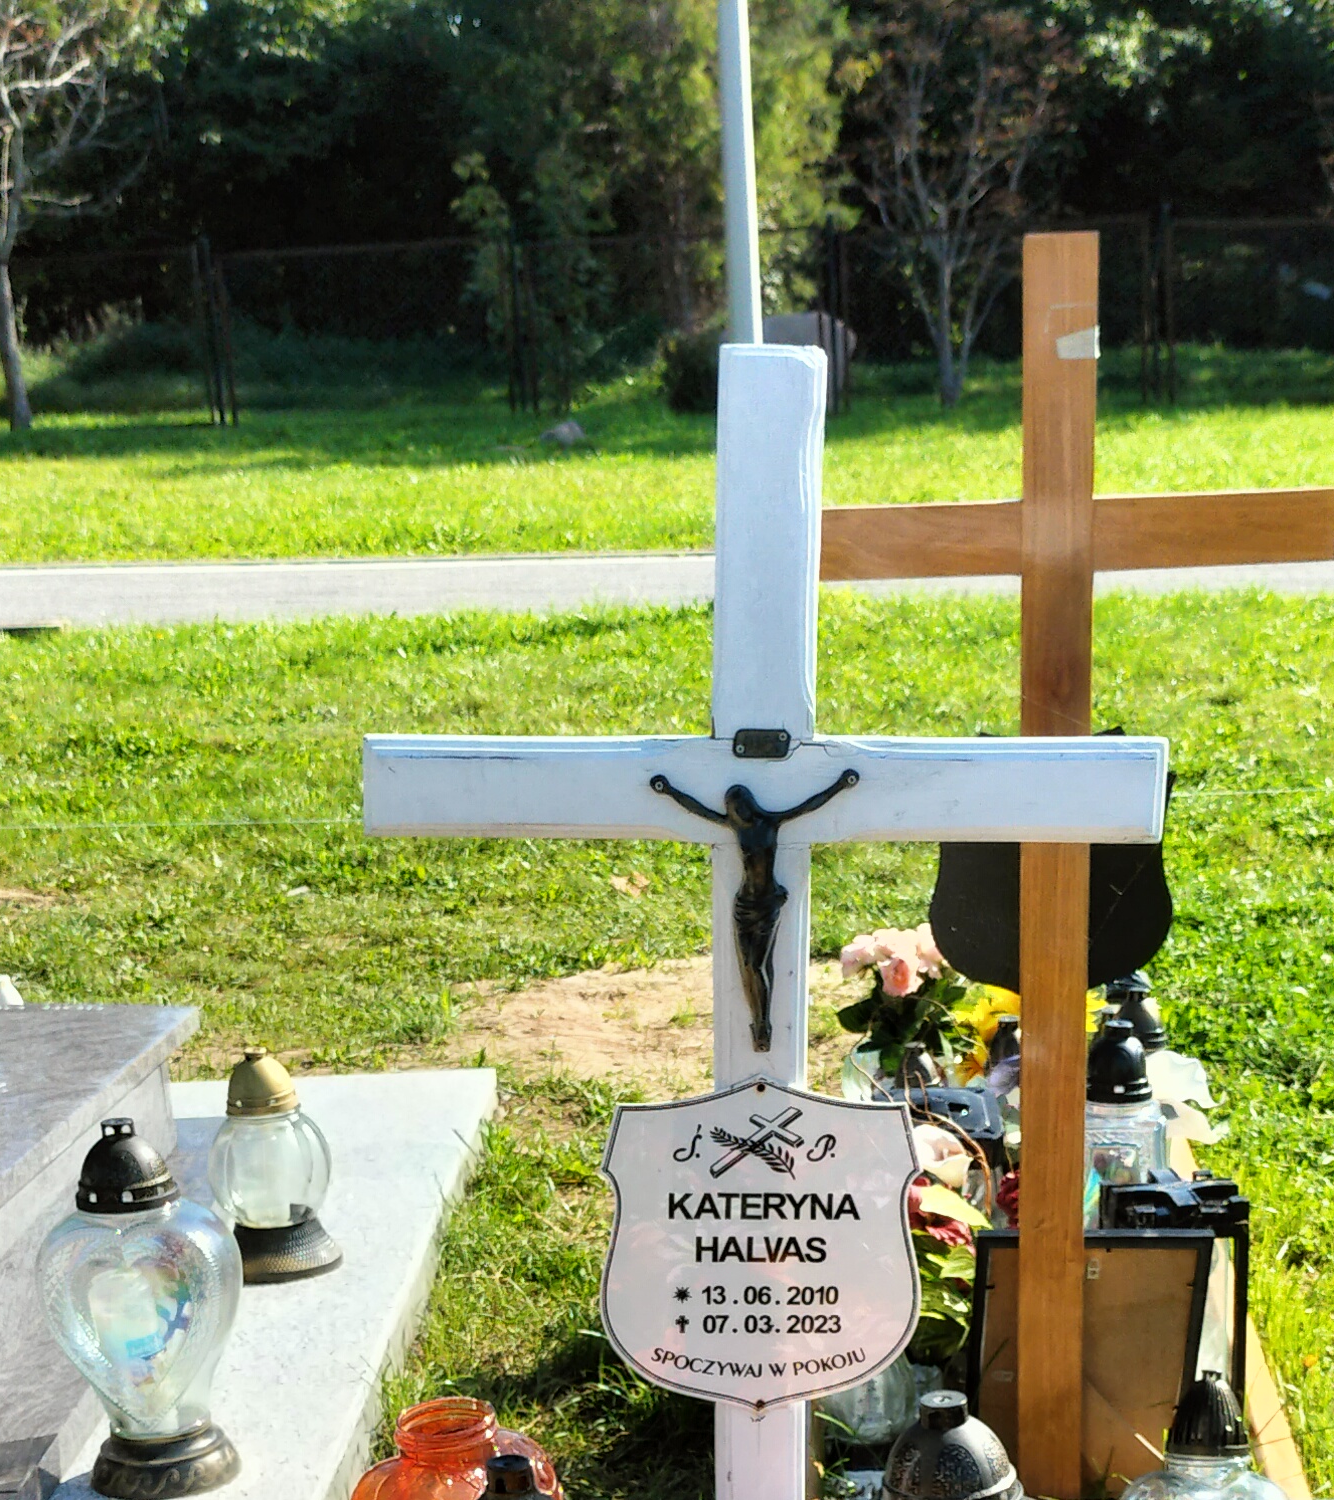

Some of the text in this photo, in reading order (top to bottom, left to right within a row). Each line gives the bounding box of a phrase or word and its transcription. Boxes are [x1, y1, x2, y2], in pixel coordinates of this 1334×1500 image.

[807, 1134, 836, 1162] P.
[667, 1192, 861, 1221] KATERYNA
[695, 1236, 827, 1263] HALVAS
[651, 1347, 866, 1378] SPOCZYWAJ W POKOJU
